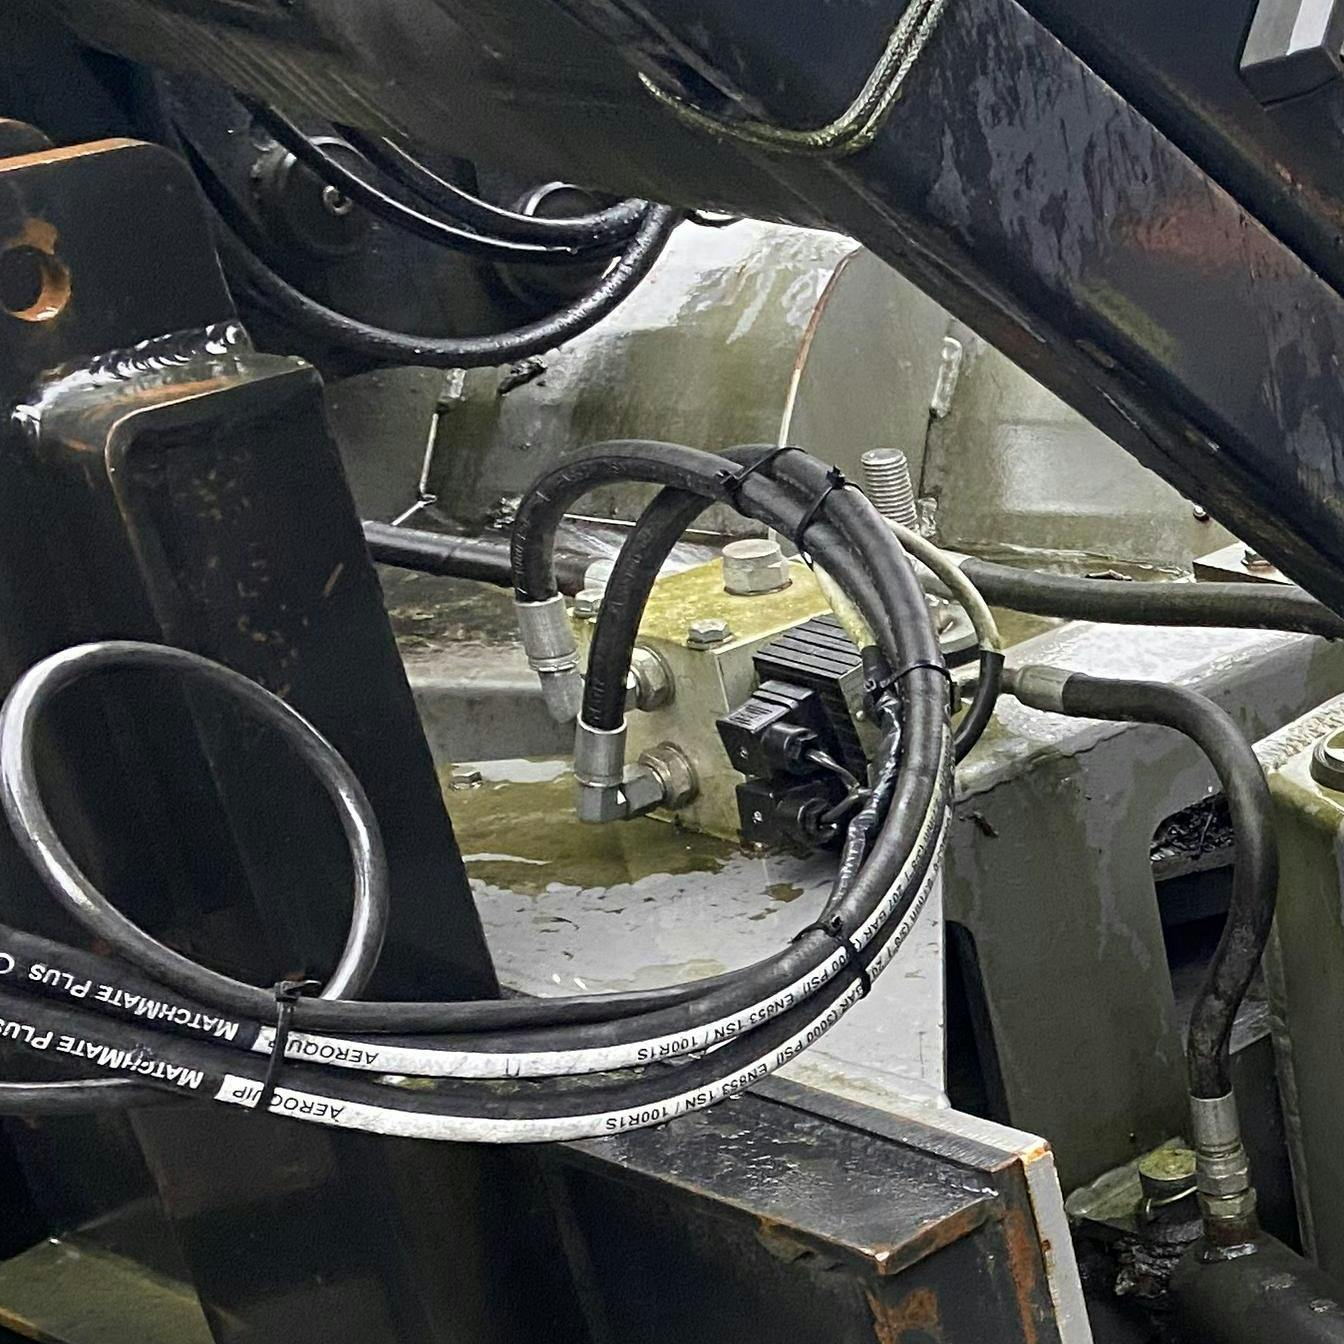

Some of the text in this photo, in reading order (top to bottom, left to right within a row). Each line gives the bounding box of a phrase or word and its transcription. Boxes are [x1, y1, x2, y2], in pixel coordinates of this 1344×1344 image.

[863, 911, 888, 941] BAR
[749, 994, 794, 1024] EN853
[714, 1019, 743, 1040] 1SN
[637, 1036, 698, 1061] 100R1S
[722, 1062, 768, 1096] EN853
[685, 1090, 716, 1110] 1SN
[606, 1106, 668, 1130] 100R1S
